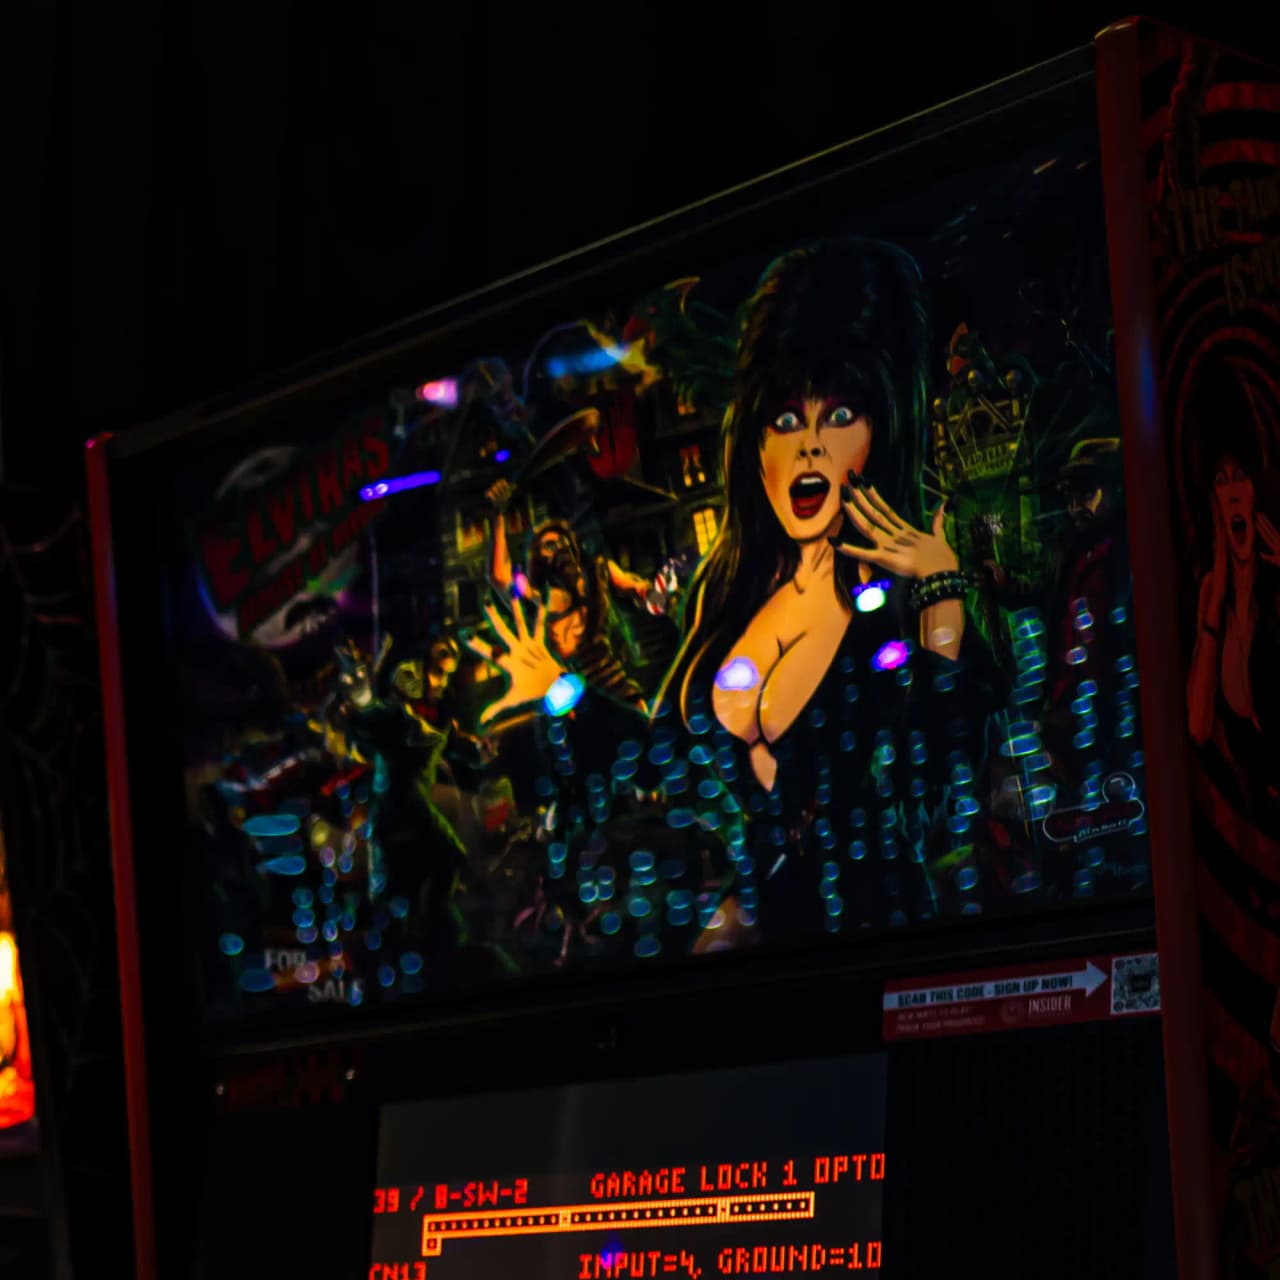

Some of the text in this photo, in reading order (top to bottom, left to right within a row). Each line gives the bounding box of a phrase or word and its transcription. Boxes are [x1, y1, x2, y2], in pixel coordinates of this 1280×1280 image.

[930, 988, 953, 1004] THIS
[957, 986, 984, 1001] CODE
[994, 982, 1020, 995] SIGN
[1024, 979, 1039, 992] UP
[1029, 995, 1072, 1015] INSIDER
[590, 1153, 886, 1199] GARAGE LOCK 1 OPTO
[578, 1241, 882, 1280] INPUT=4, GROUND=10
